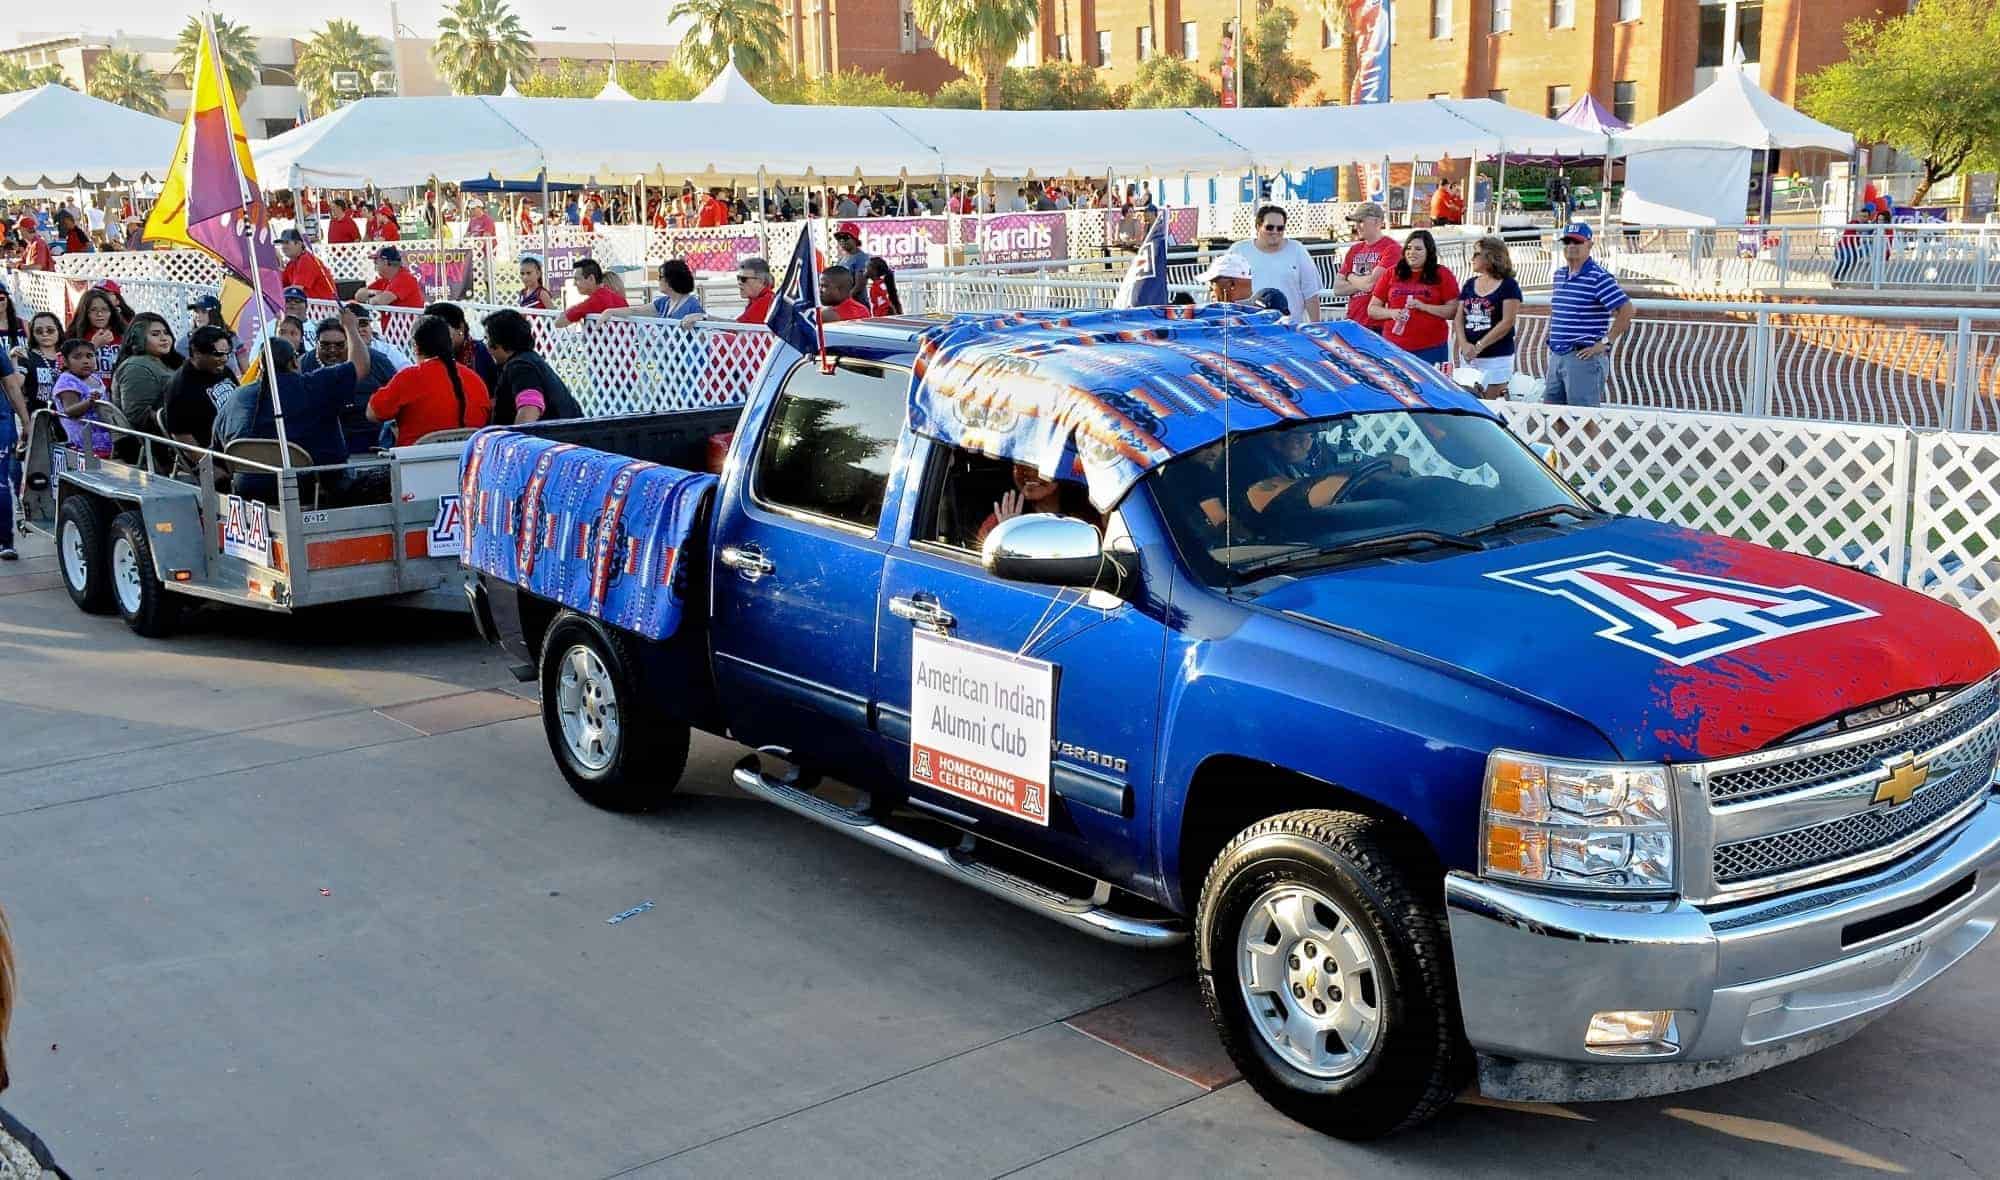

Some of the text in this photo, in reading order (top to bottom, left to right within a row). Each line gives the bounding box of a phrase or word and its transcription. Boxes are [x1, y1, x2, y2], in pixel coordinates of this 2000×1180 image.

[1416, 162, 1433, 176] WIN
[445, 251, 466, 264] OUT
[1484, 550, 1883, 667] A
[917, 661, 1046, 720] American Indian
[931, 705, 1028, 758] Alumni Club
[915, 751, 933, 779] A
[1050, 739, 1128, 772] VERADO
[939, 756, 1016, 793] HOMECOMING
[939, 771, 1016, 806] CELEBRATION
[1021, 784, 1043, 815] A
